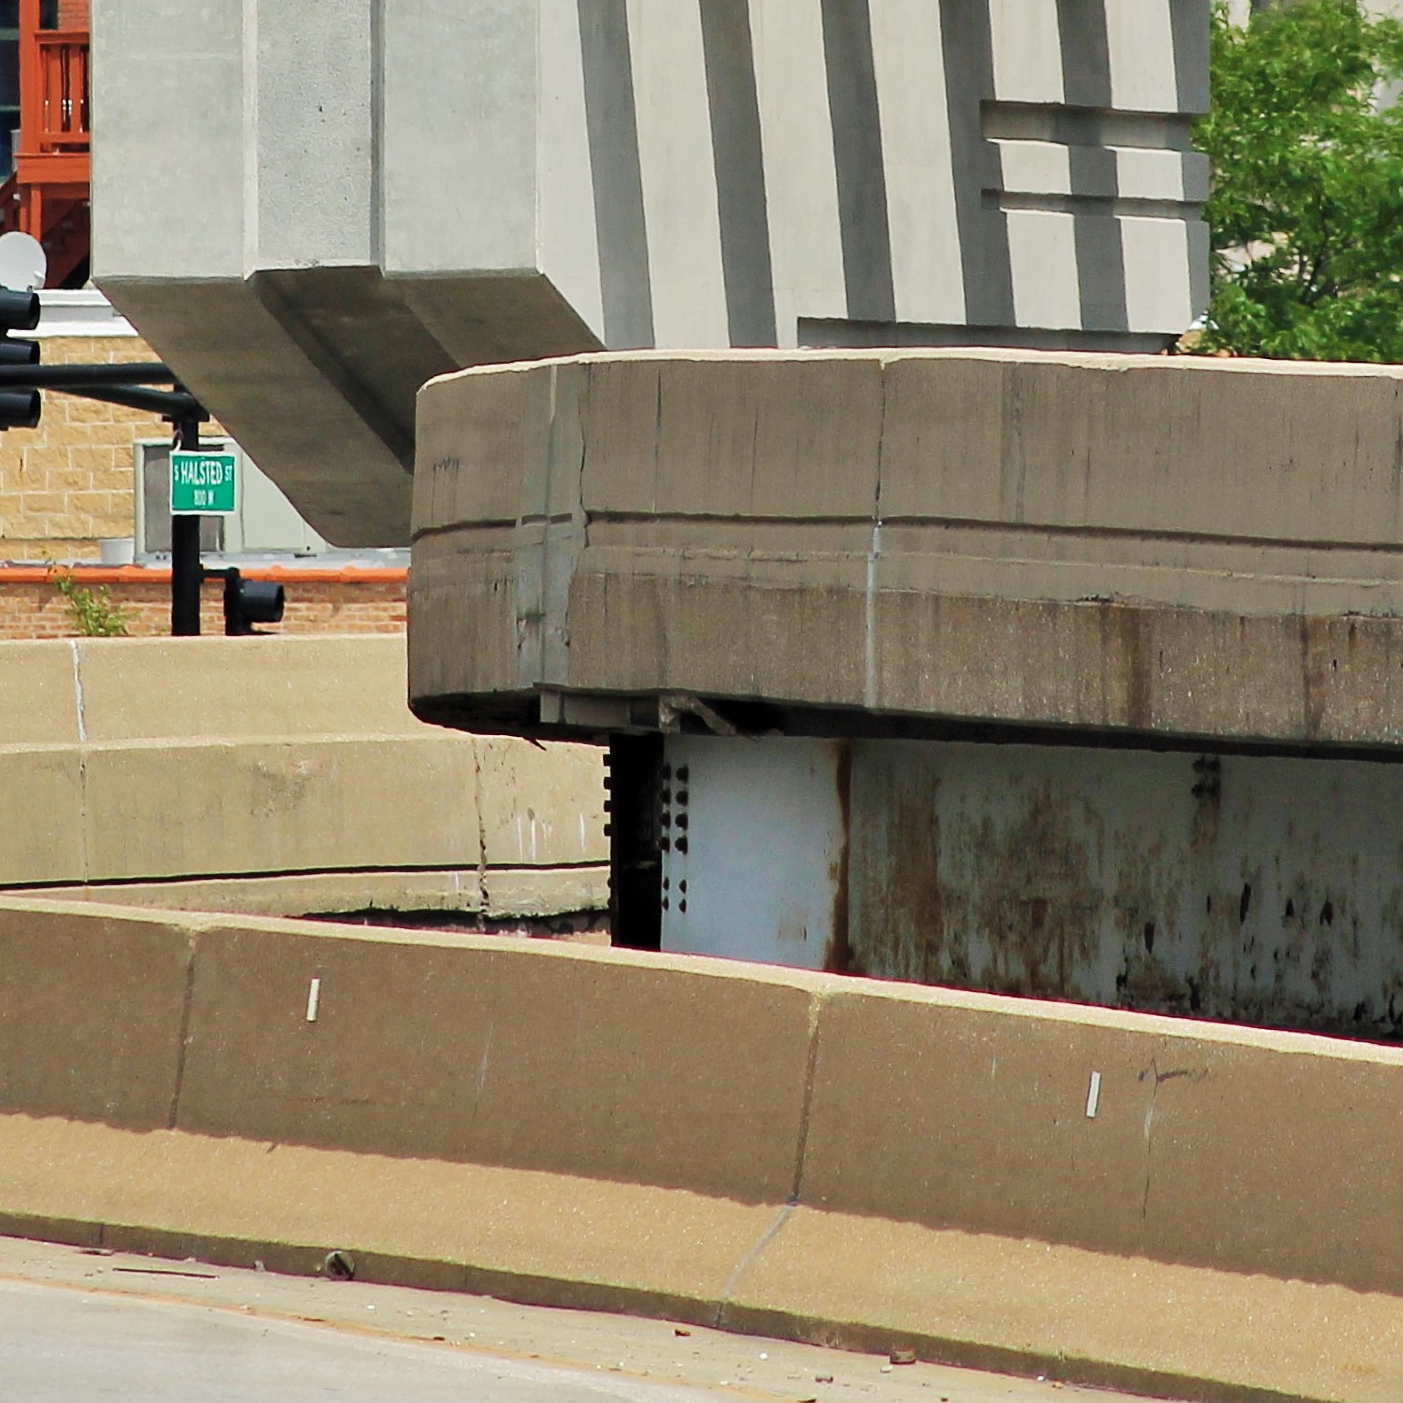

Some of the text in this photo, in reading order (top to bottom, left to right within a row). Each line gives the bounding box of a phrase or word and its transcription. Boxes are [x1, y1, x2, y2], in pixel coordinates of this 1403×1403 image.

[174, 461, 232, 485] S HALSTED ST
